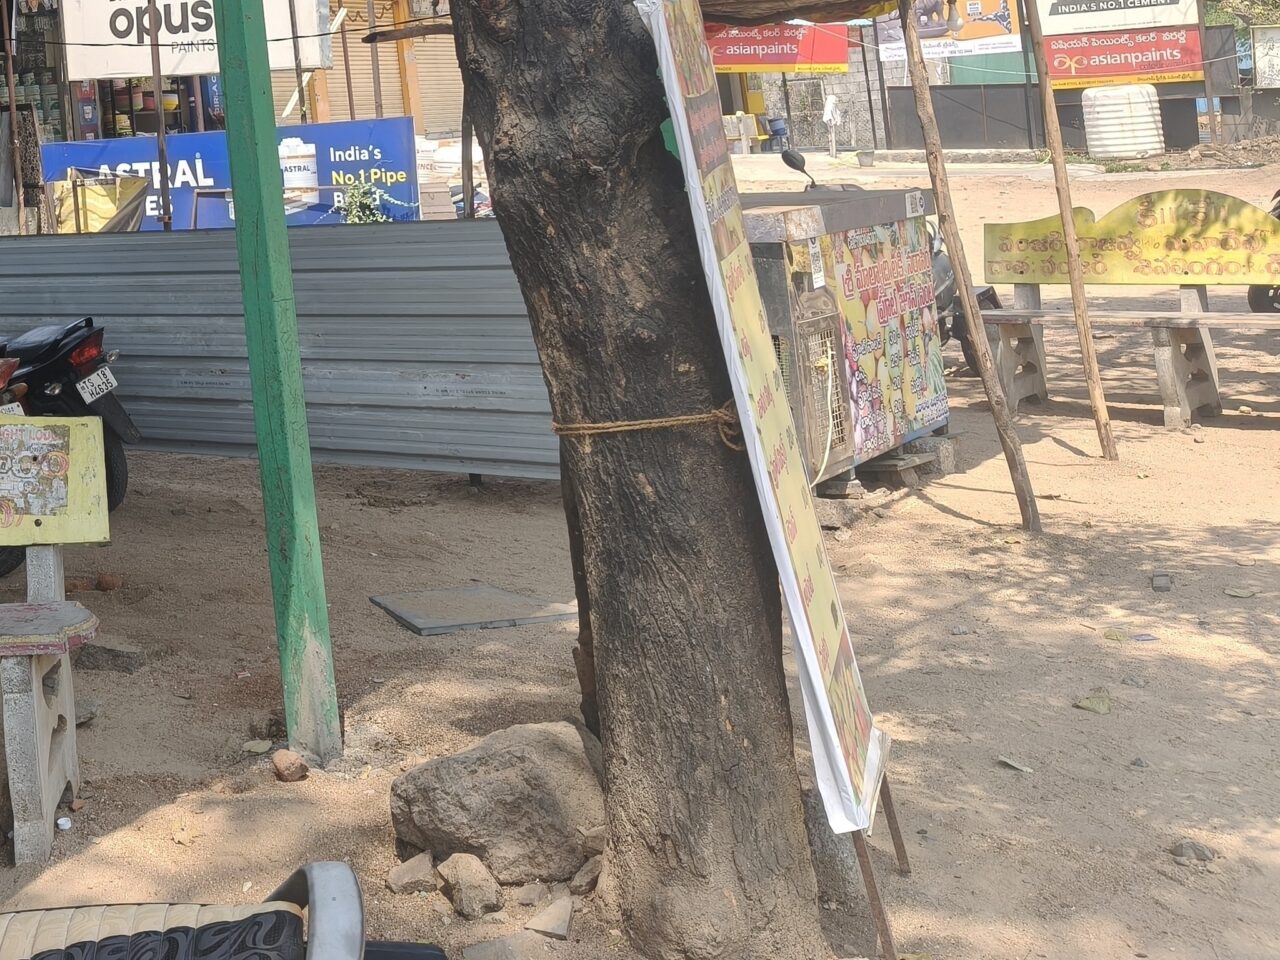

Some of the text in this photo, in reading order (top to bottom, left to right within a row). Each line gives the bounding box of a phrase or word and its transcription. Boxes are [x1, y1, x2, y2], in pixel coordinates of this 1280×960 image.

[1058, 3, 1096, 14] INDIA'S
[109, 0, 213, 44] opus
[171, 39, 217, 54] PAINTS
[726, 41, 798, 59] asianpaints
[1090, 46, 1181, 69] asianpaints
[329, 145, 381, 162] India's
[283, 164, 310, 173] ASTRAL
[331, 168, 407, 187] No.1 Pipe
[82, 370, 108, 390] TS 18
[88, 378, 113, 399] H4635
